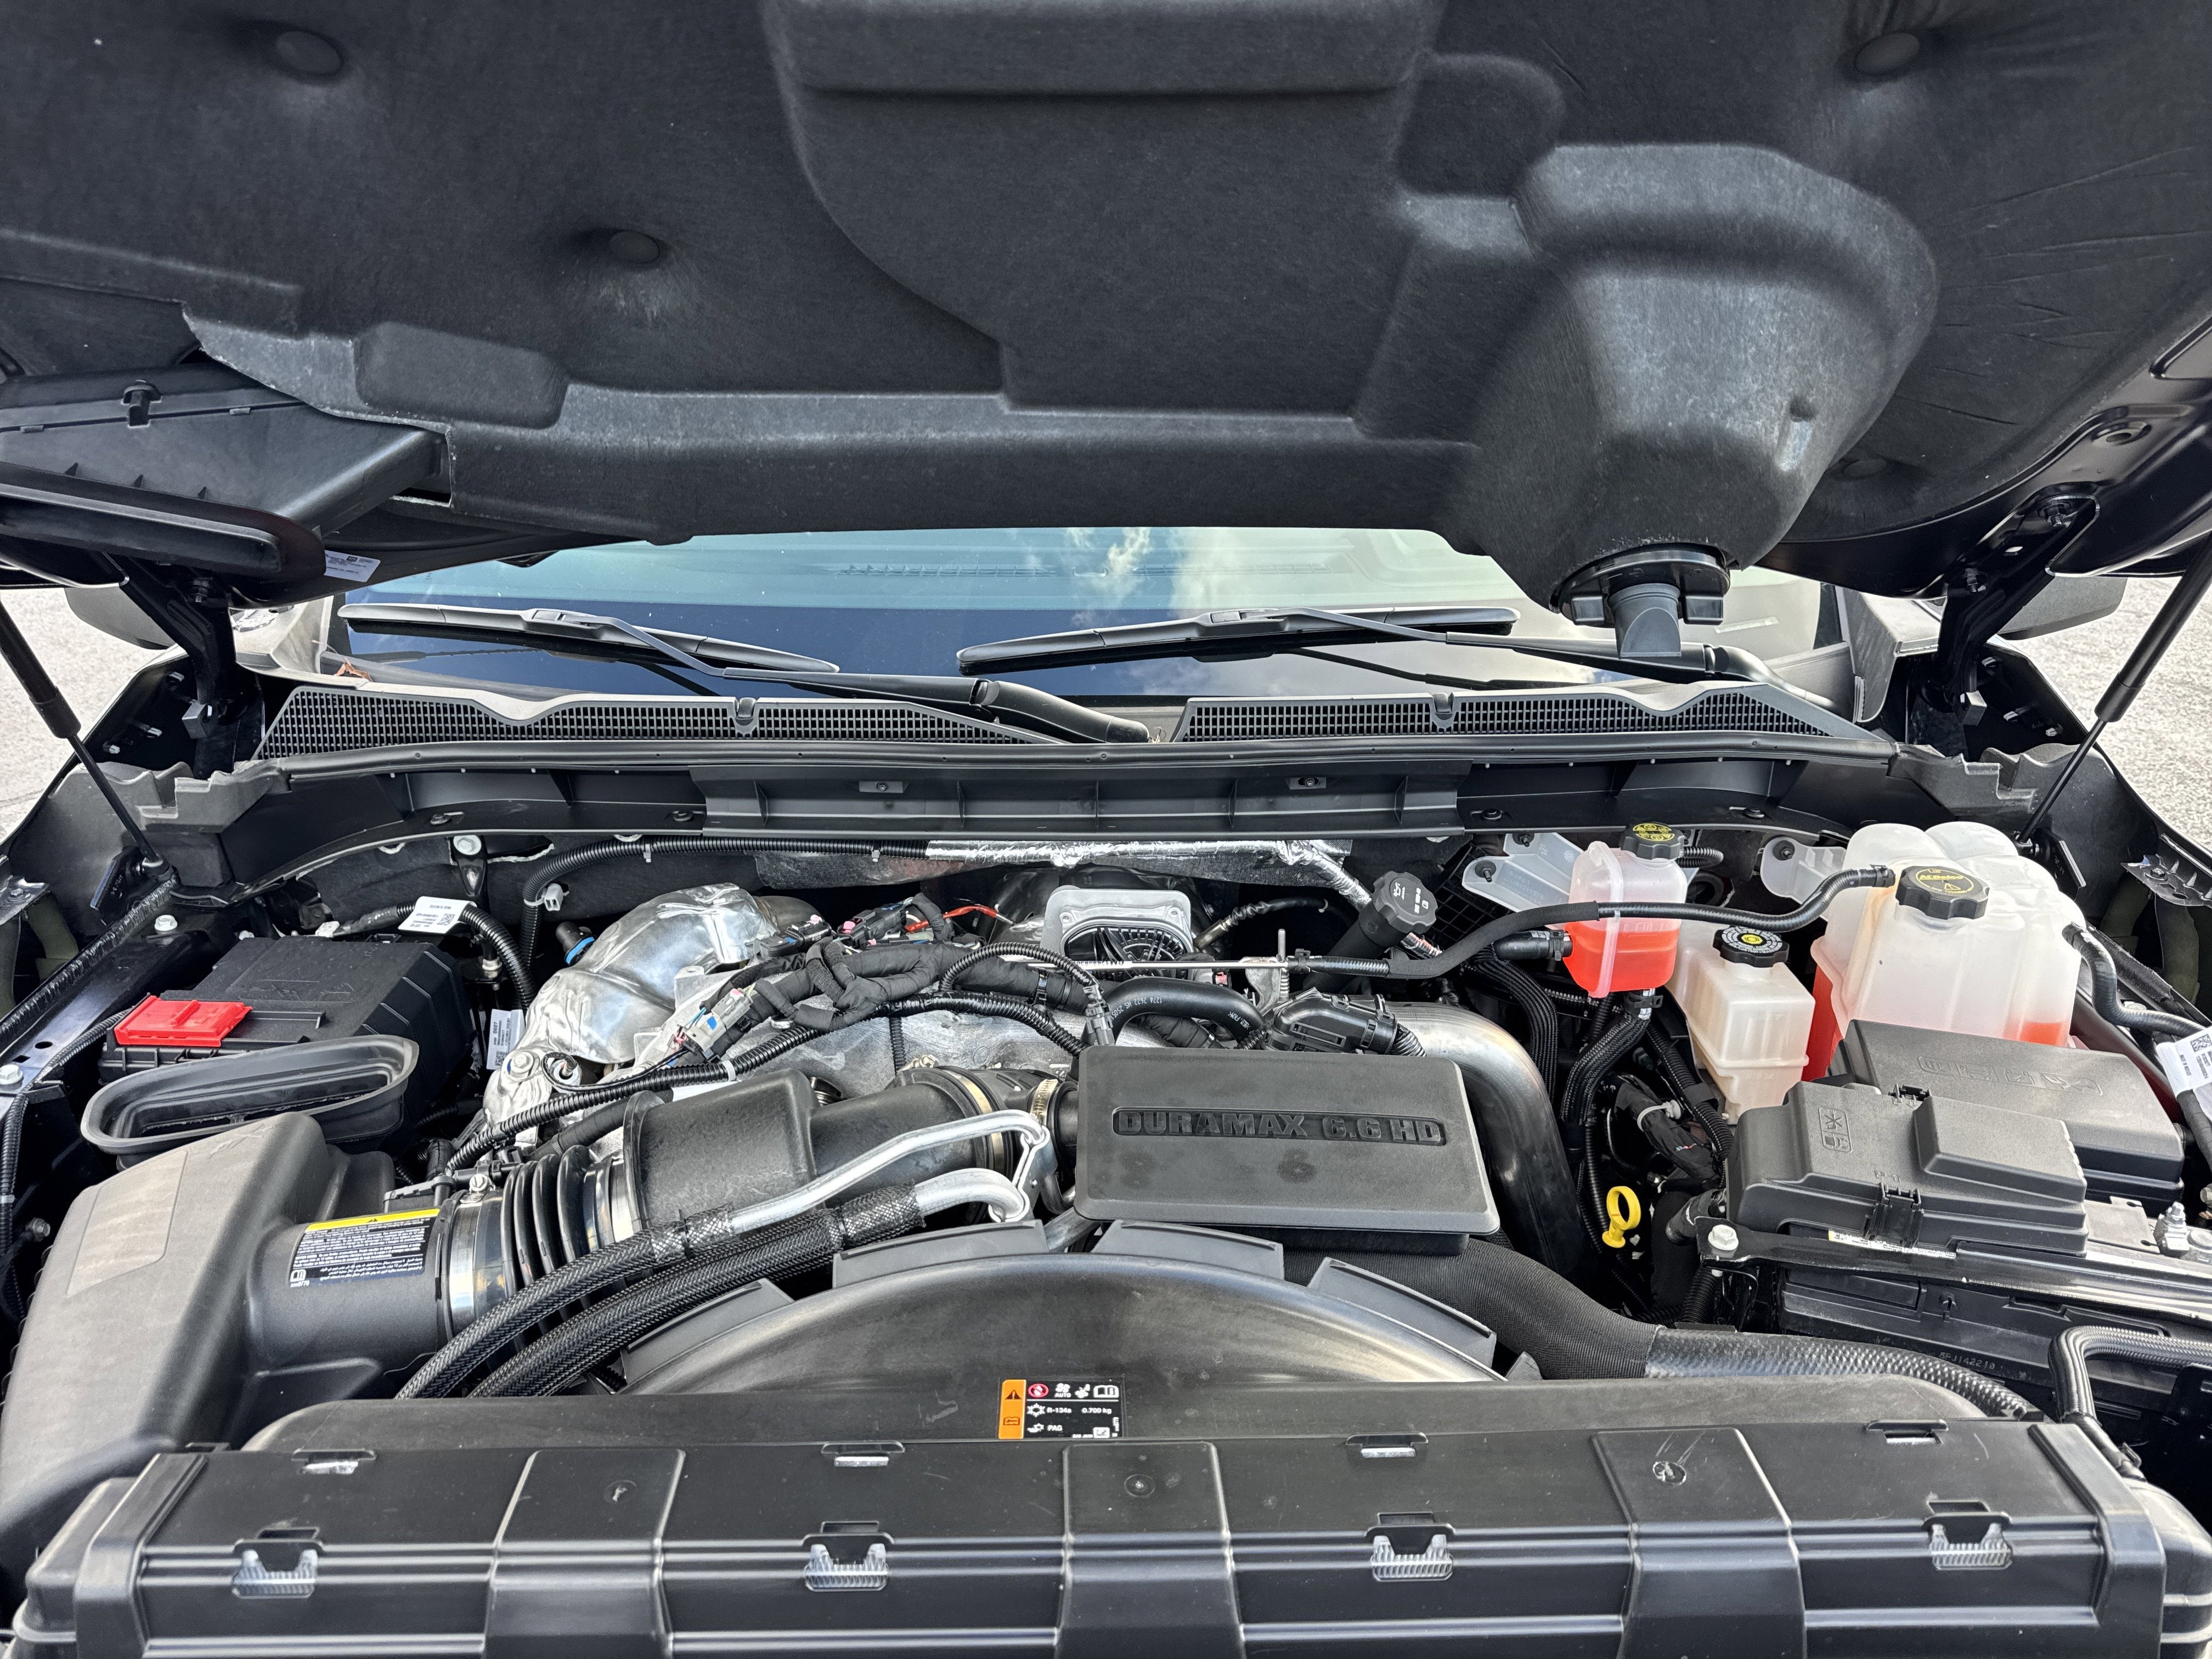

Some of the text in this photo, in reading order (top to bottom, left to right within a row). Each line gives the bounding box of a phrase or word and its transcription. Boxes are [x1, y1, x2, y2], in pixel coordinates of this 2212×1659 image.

[1124, 1000, 1132, 1009] HS
[1133, 997, 1147, 1006] 2622
[1119, 1111, 1441, 1143] DURAMAX 6.6 HD
